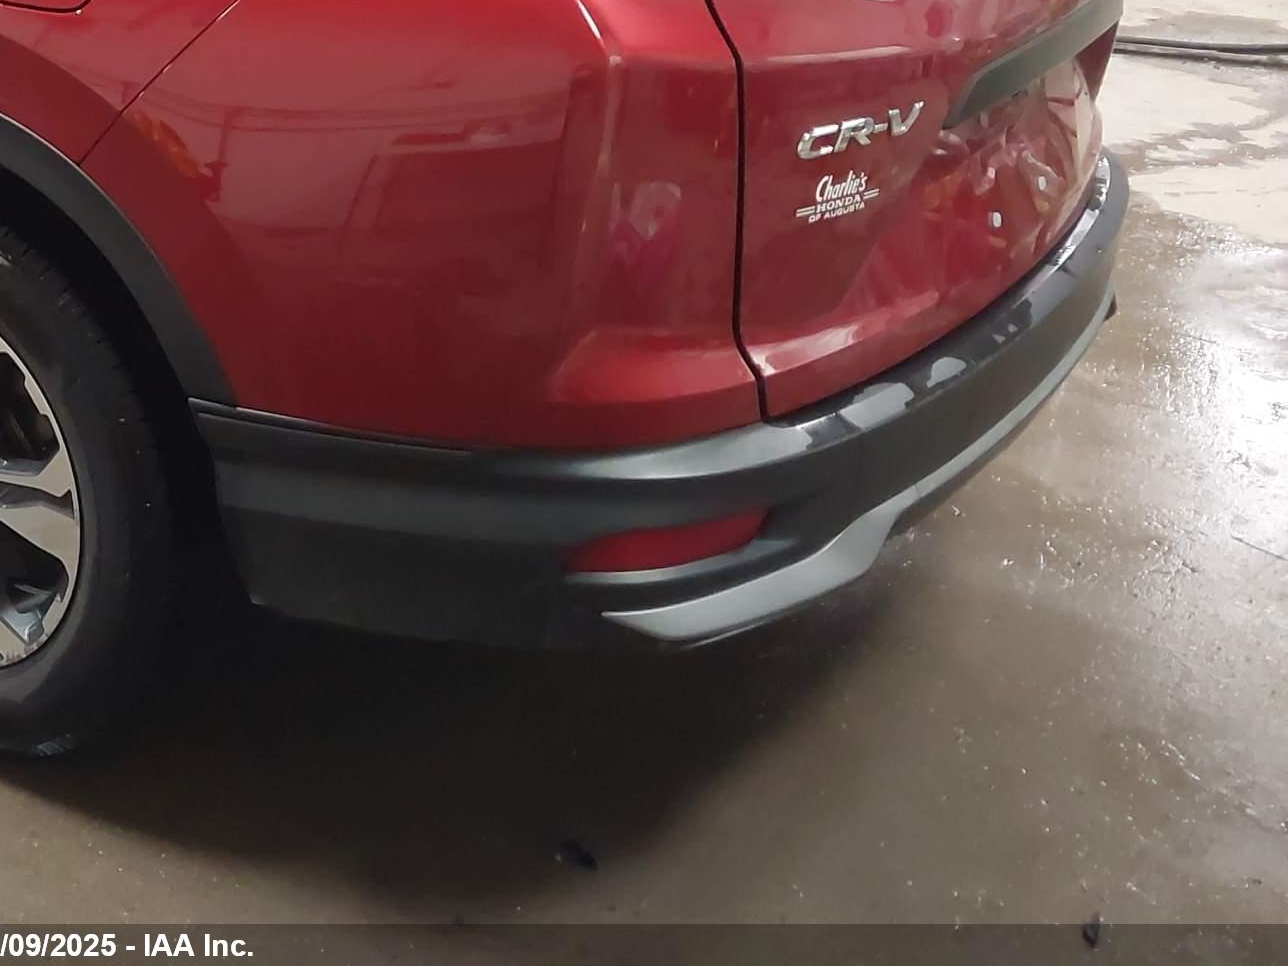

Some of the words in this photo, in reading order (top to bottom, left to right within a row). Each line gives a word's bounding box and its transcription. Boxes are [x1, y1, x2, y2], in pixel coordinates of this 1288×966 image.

[797, 101, 925, 160] CR-V
[815, 169, 869, 203] Charlie's
[808, 214, 822, 224] OF
[824, 201, 866, 220] AUGUSTA
[816, 194, 862, 213] HONDA
